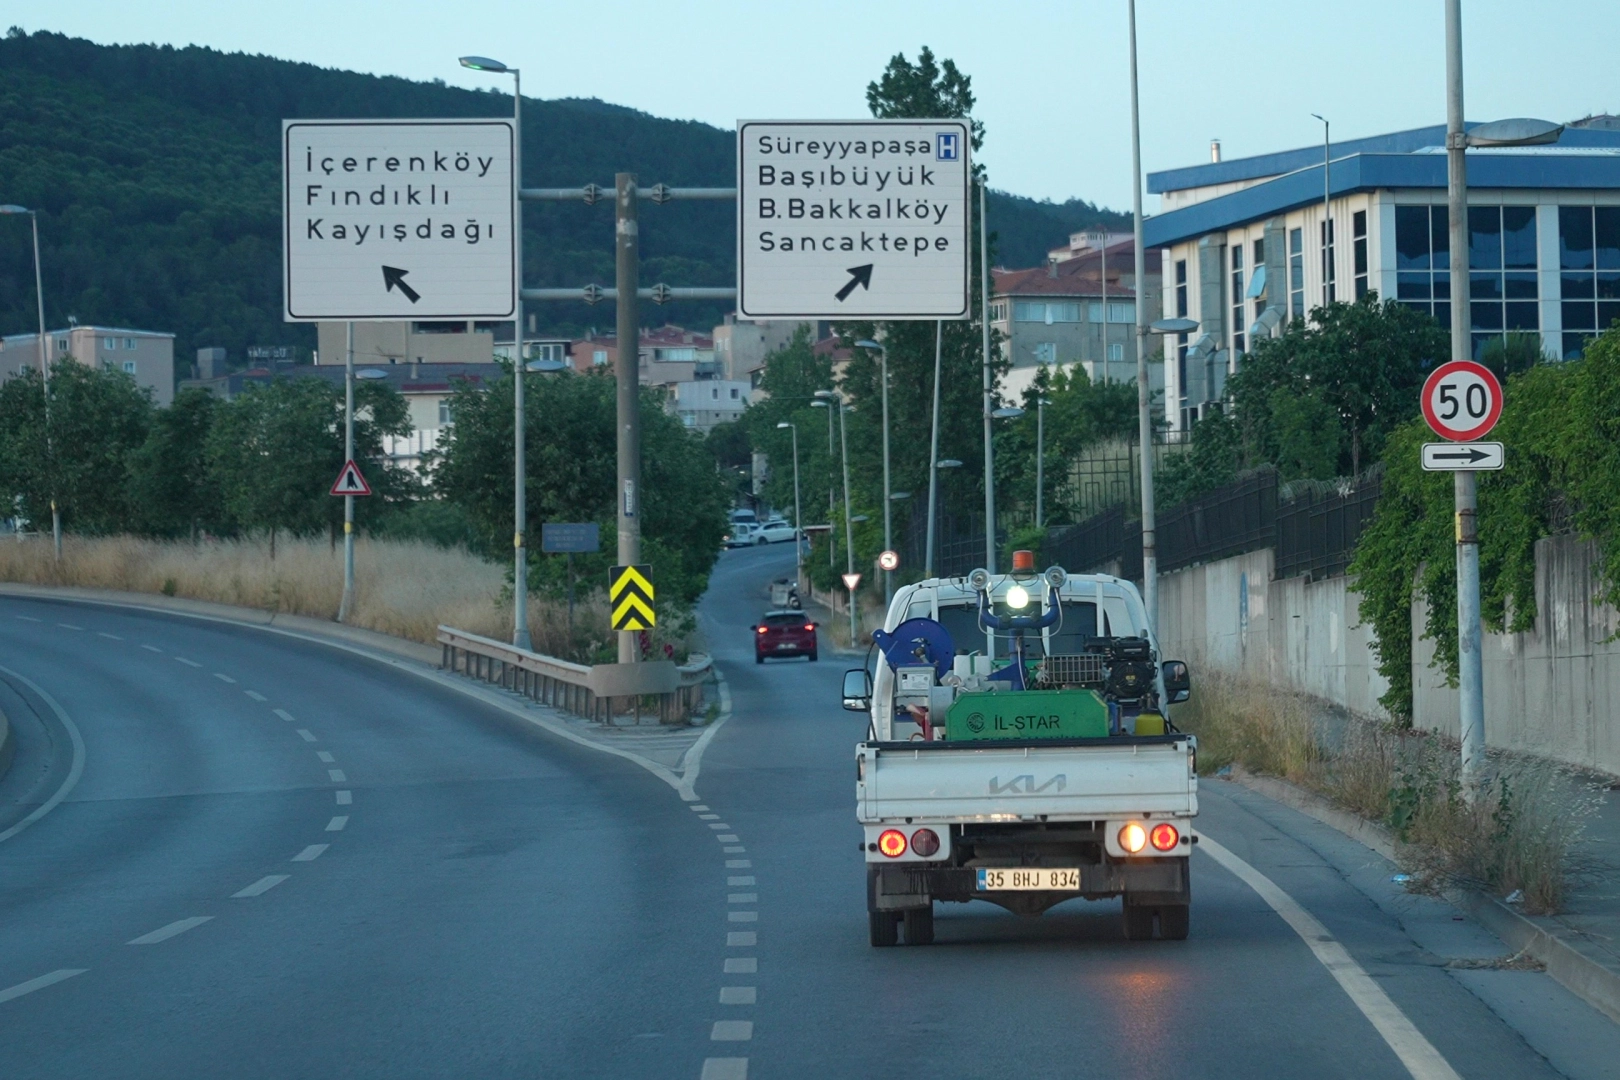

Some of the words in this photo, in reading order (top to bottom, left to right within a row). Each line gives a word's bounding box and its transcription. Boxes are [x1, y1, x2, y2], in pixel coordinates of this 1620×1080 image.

[758, 135, 931, 160] Süreyyapaşa
[939, 136, 956, 158] H
[307, 146, 493, 177] İçerenköy
[758, 164, 935, 192] Başıbüyük
[307, 184, 449, 206] Fındıklı
[758, 198, 949, 225] B.Bakkalköy
[307, 218, 493, 245] Kayışdağı
[758, 231, 949, 257] Sancaktepe
[1439, 383, 1487, 420] 50
[987, 872, 1004, 887] 35
[1013, 872, 1040, 887] BHJ
[1050, 872, 1077, 887] 834
